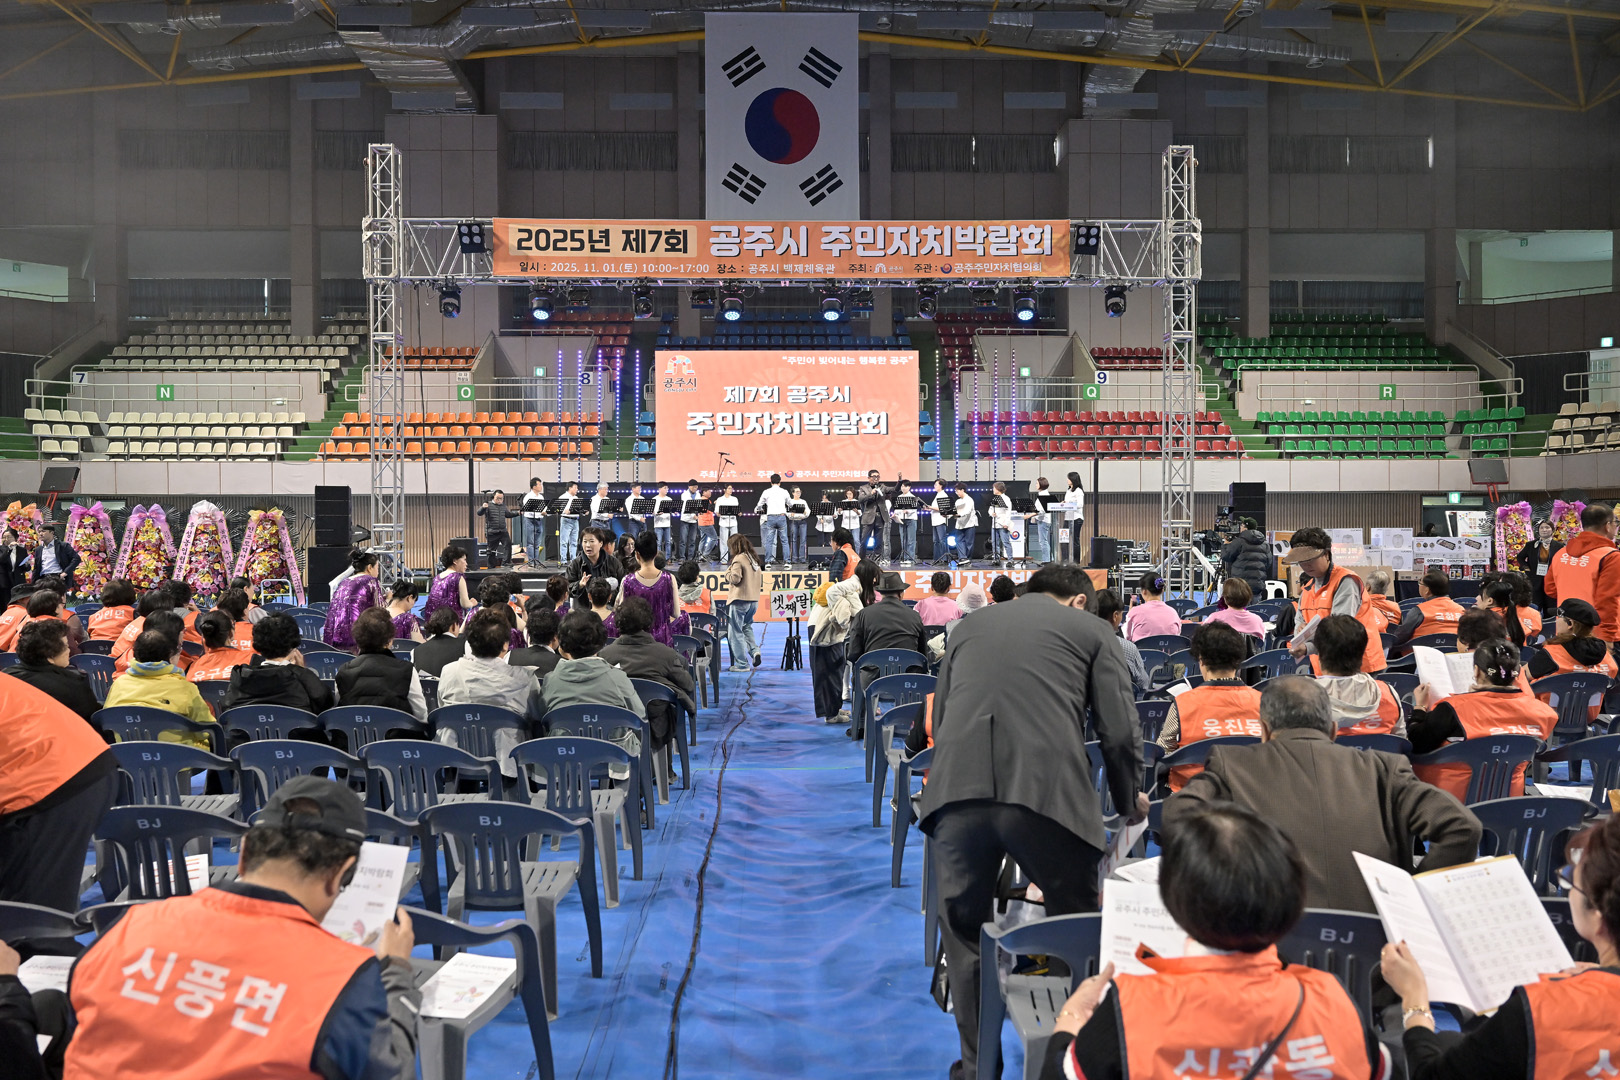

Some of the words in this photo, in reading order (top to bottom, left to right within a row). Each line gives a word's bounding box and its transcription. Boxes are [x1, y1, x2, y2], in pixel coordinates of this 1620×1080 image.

[517, 228, 611, 253] 2025년
[621, 228, 688, 254] 제7회
[709, 225, 809, 258] 공주시
[820, 224, 1053, 257] 주민자치박람회
[519, 261, 540, 272] 일시
[550, 262, 580, 273] 2025.
[583, 262, 599, 273] 11.
[603, 261, 638, 274] 01.(토)
[642, 263, 710, 274] 10:00~17:00
[717, 263, 737, 274] 장소
[748, 263, 779, 274] 공주시
[783, 263, 836, 275] 백제체육관
[848, 263, 867, 274] 주최
[914, 263, 932, 274] 주관
[954, 262, 1042, 273] 공주주민자치협의회
[819, 355, 856, 365] 빚어내는
[859, 355, 887, 365] 행복한
[75, 373, 86, 383] 7
[581, 372, 591, 384] 8
[663, 377, 697, 388] 공주시
[1097, 371, 1107, 384] 9
[160, 387, 170, 398] N
[723, 385, 780, 404] 제7회
[787, 385, 851, 404] 공주시
[1086, 386, 1097, 398] Q
[1382, 386, 1393, 397] R
[686, 411, 889, 436] 주민자치박람회
[796, 470, 819, 479] 공주시
[125, 715, 141, 723] BJ
[258, 714, 274, 722] BJ
[355, 715, 371, 723] BJ
[465, 713, 481, 721] BJ
[583, 714, 598, 722] BJ
[1148, 710, 1163, 718] BJ
[1202, 718, 1262, 737] 웅진동
[274, 749, 294, 759] BJ
[402, 750, 421, 759] BJ
[557, 746, 575, 755] BJ
[1491, 744, 1510, 754] BJ
[141, 752, 161, 761] BJ
[1523, 807, 1547, 819] BJ
[136, 818, 161, 829] BJ
[479, 815, 502, 826] BJ
[1320, 928, 1354, 944] BJ
[120, 947, 287, 1037] 신풍면
